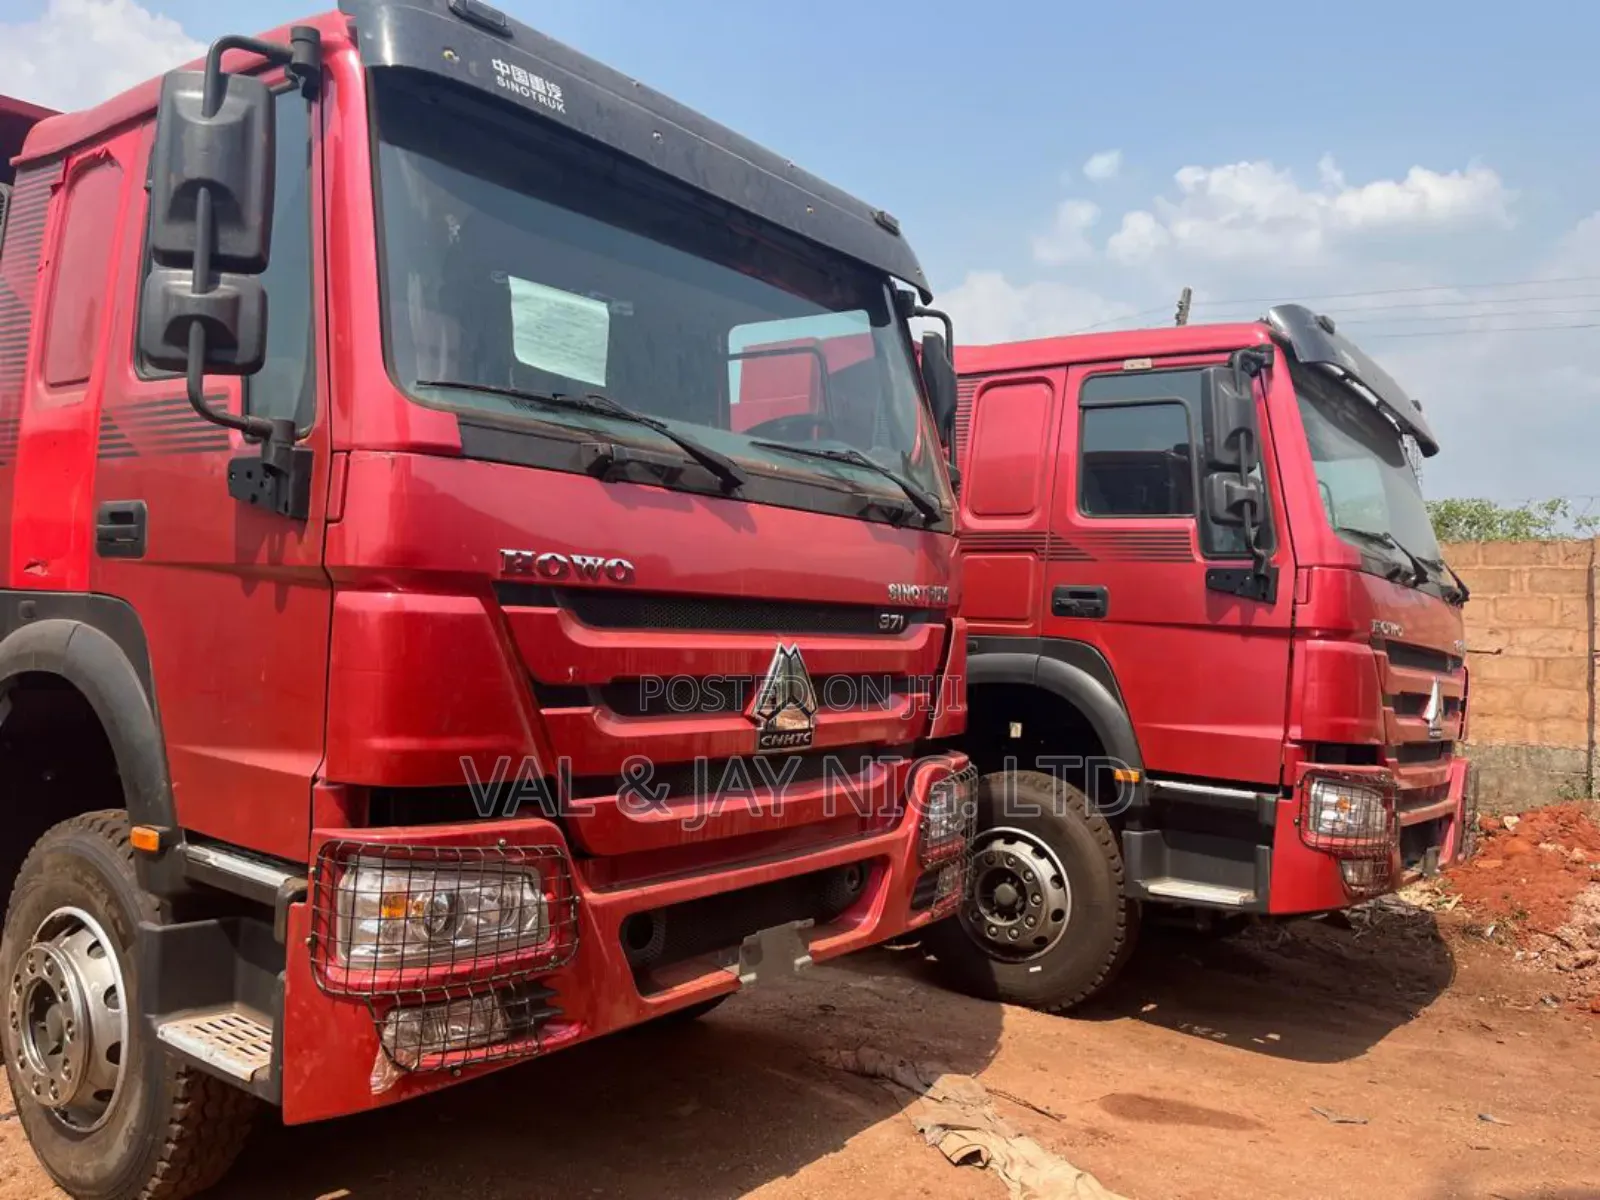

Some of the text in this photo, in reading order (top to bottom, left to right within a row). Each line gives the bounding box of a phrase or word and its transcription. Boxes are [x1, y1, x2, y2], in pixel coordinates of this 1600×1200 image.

[491, 58, 564, 103] 中国重汽
[496, 75, 566, 114] SINOTRUK
[499, 549, 635, 583] HOWO
[879, 613, 904, 629] 371
[760, 731, 812, 746] CNHTC
